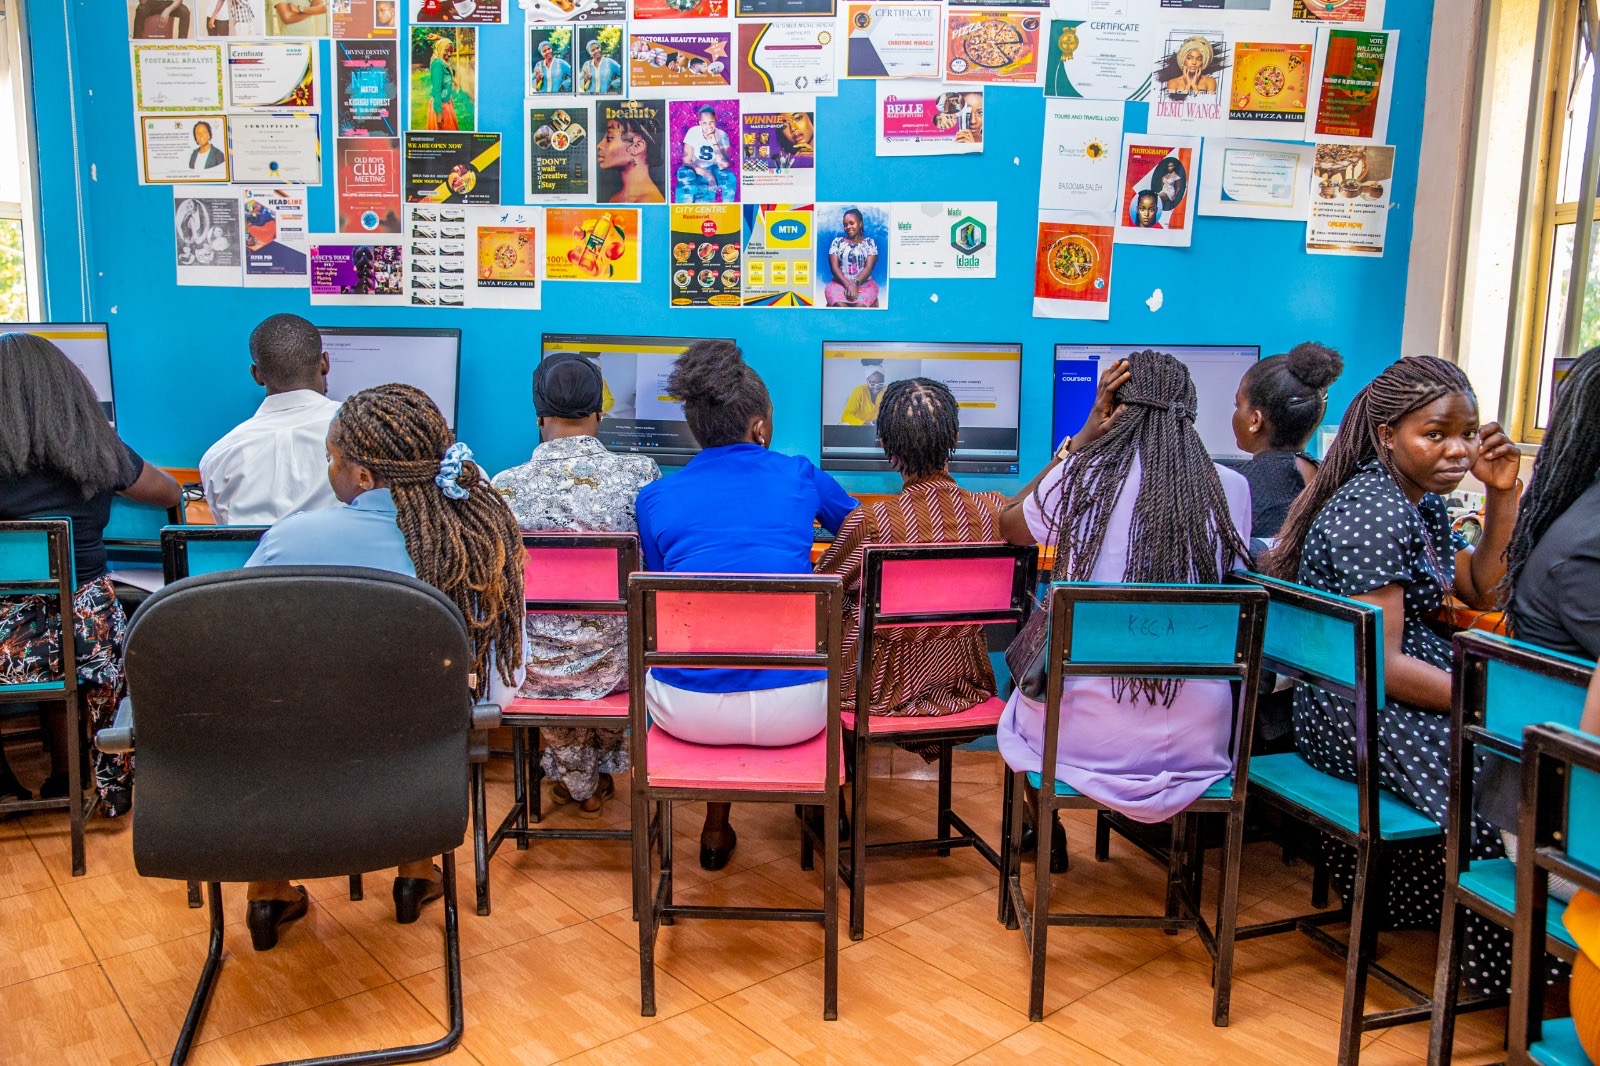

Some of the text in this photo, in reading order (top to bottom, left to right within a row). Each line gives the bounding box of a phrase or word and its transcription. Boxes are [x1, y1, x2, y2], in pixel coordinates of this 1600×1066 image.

[1090, 22, 1140, 31] CERTIFICATE
[606, 107, 658, 119] beauty
[887, 104, 924, 114] BELLE
[1156, 102, 1183, 117] DEMU
[699, 145, 713, 160] S
[353, 163, 385, 175] CLUB
[541, 182, 555, 190] Stay
[956, 255, 980, 266] Wada
